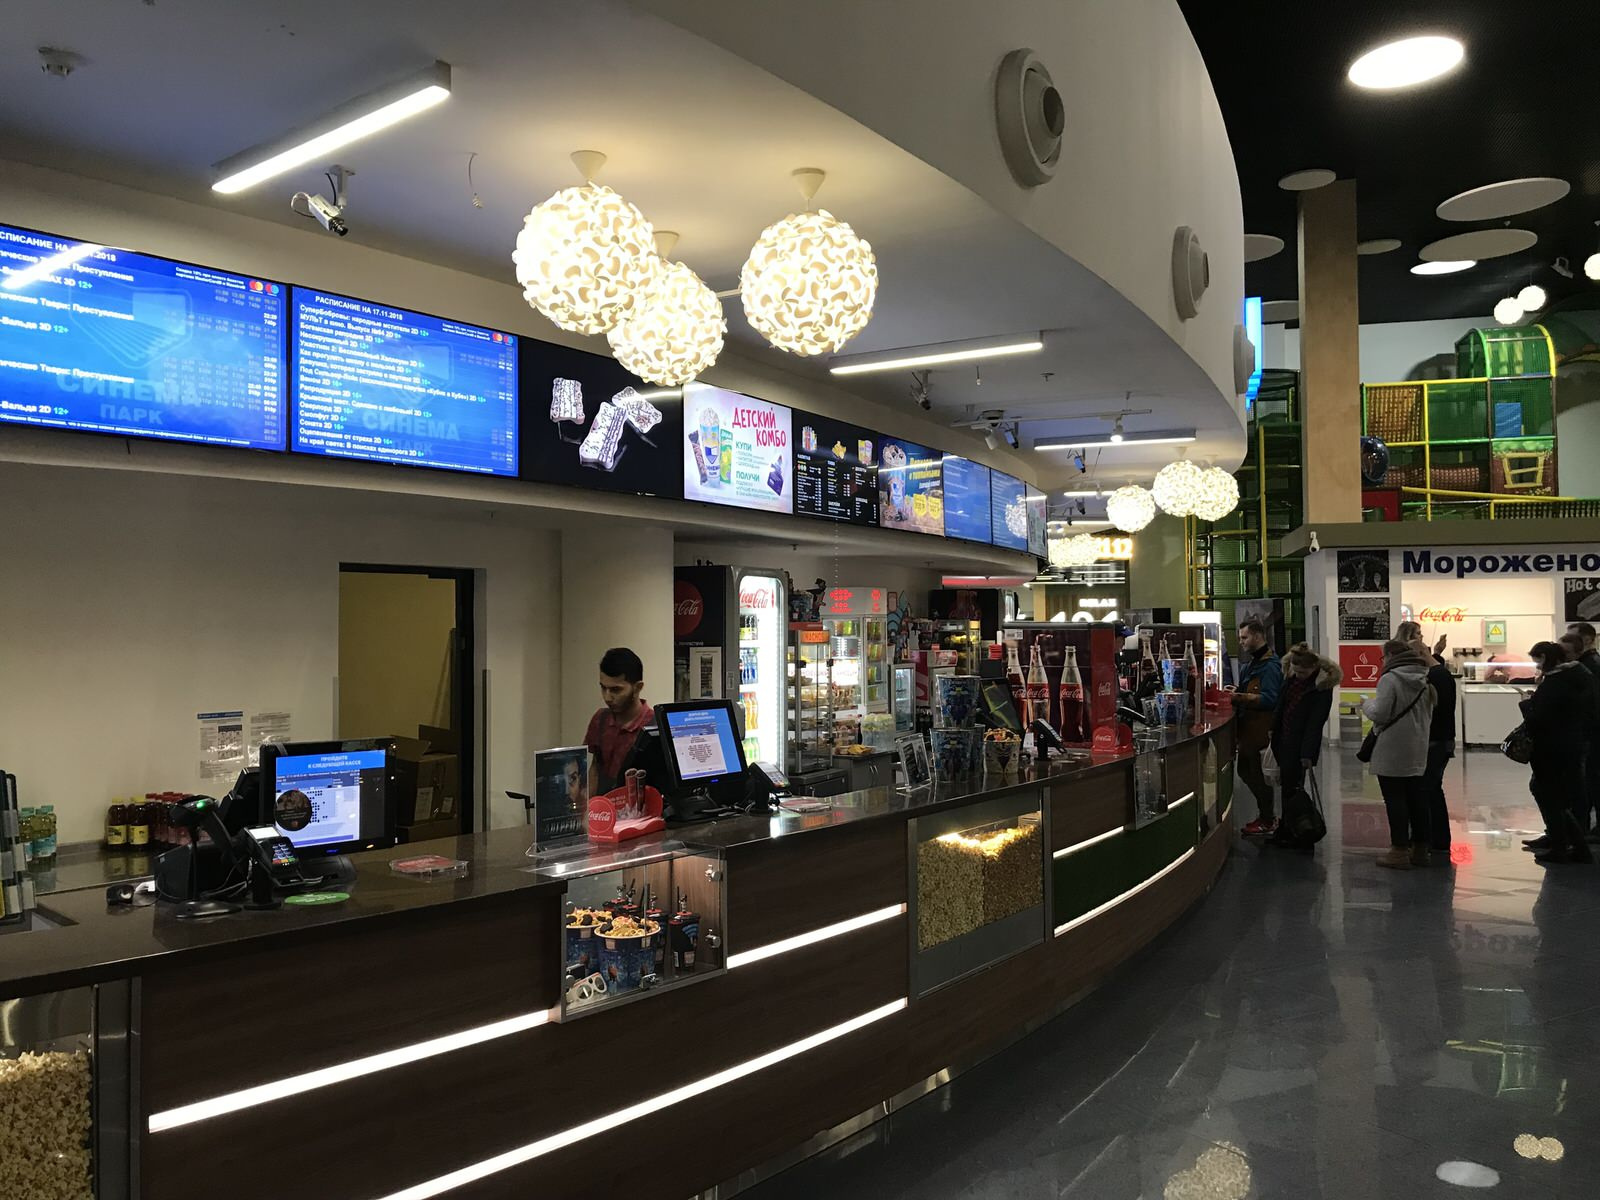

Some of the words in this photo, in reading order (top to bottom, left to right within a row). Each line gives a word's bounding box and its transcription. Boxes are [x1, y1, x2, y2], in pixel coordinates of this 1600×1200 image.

[315, 295, 360, 311] РАСПИСАНИЕ
[362, 305, 371, 313] НА
[373, 308, 402, 320] 17.11.2018
[100, 403, 162, 424] ПАРК
[732, 407, 776, 429] ДЕТСКИЙ
[735, 441, 752, 451] КУПИ
[755, 429, 787, 448] КОМБО
[736, 470, 760, 482] ПОЛУЧИ
[1565, 578, 1594, 593] Hot
[588, 810, 611, 822] Coca-Cola
